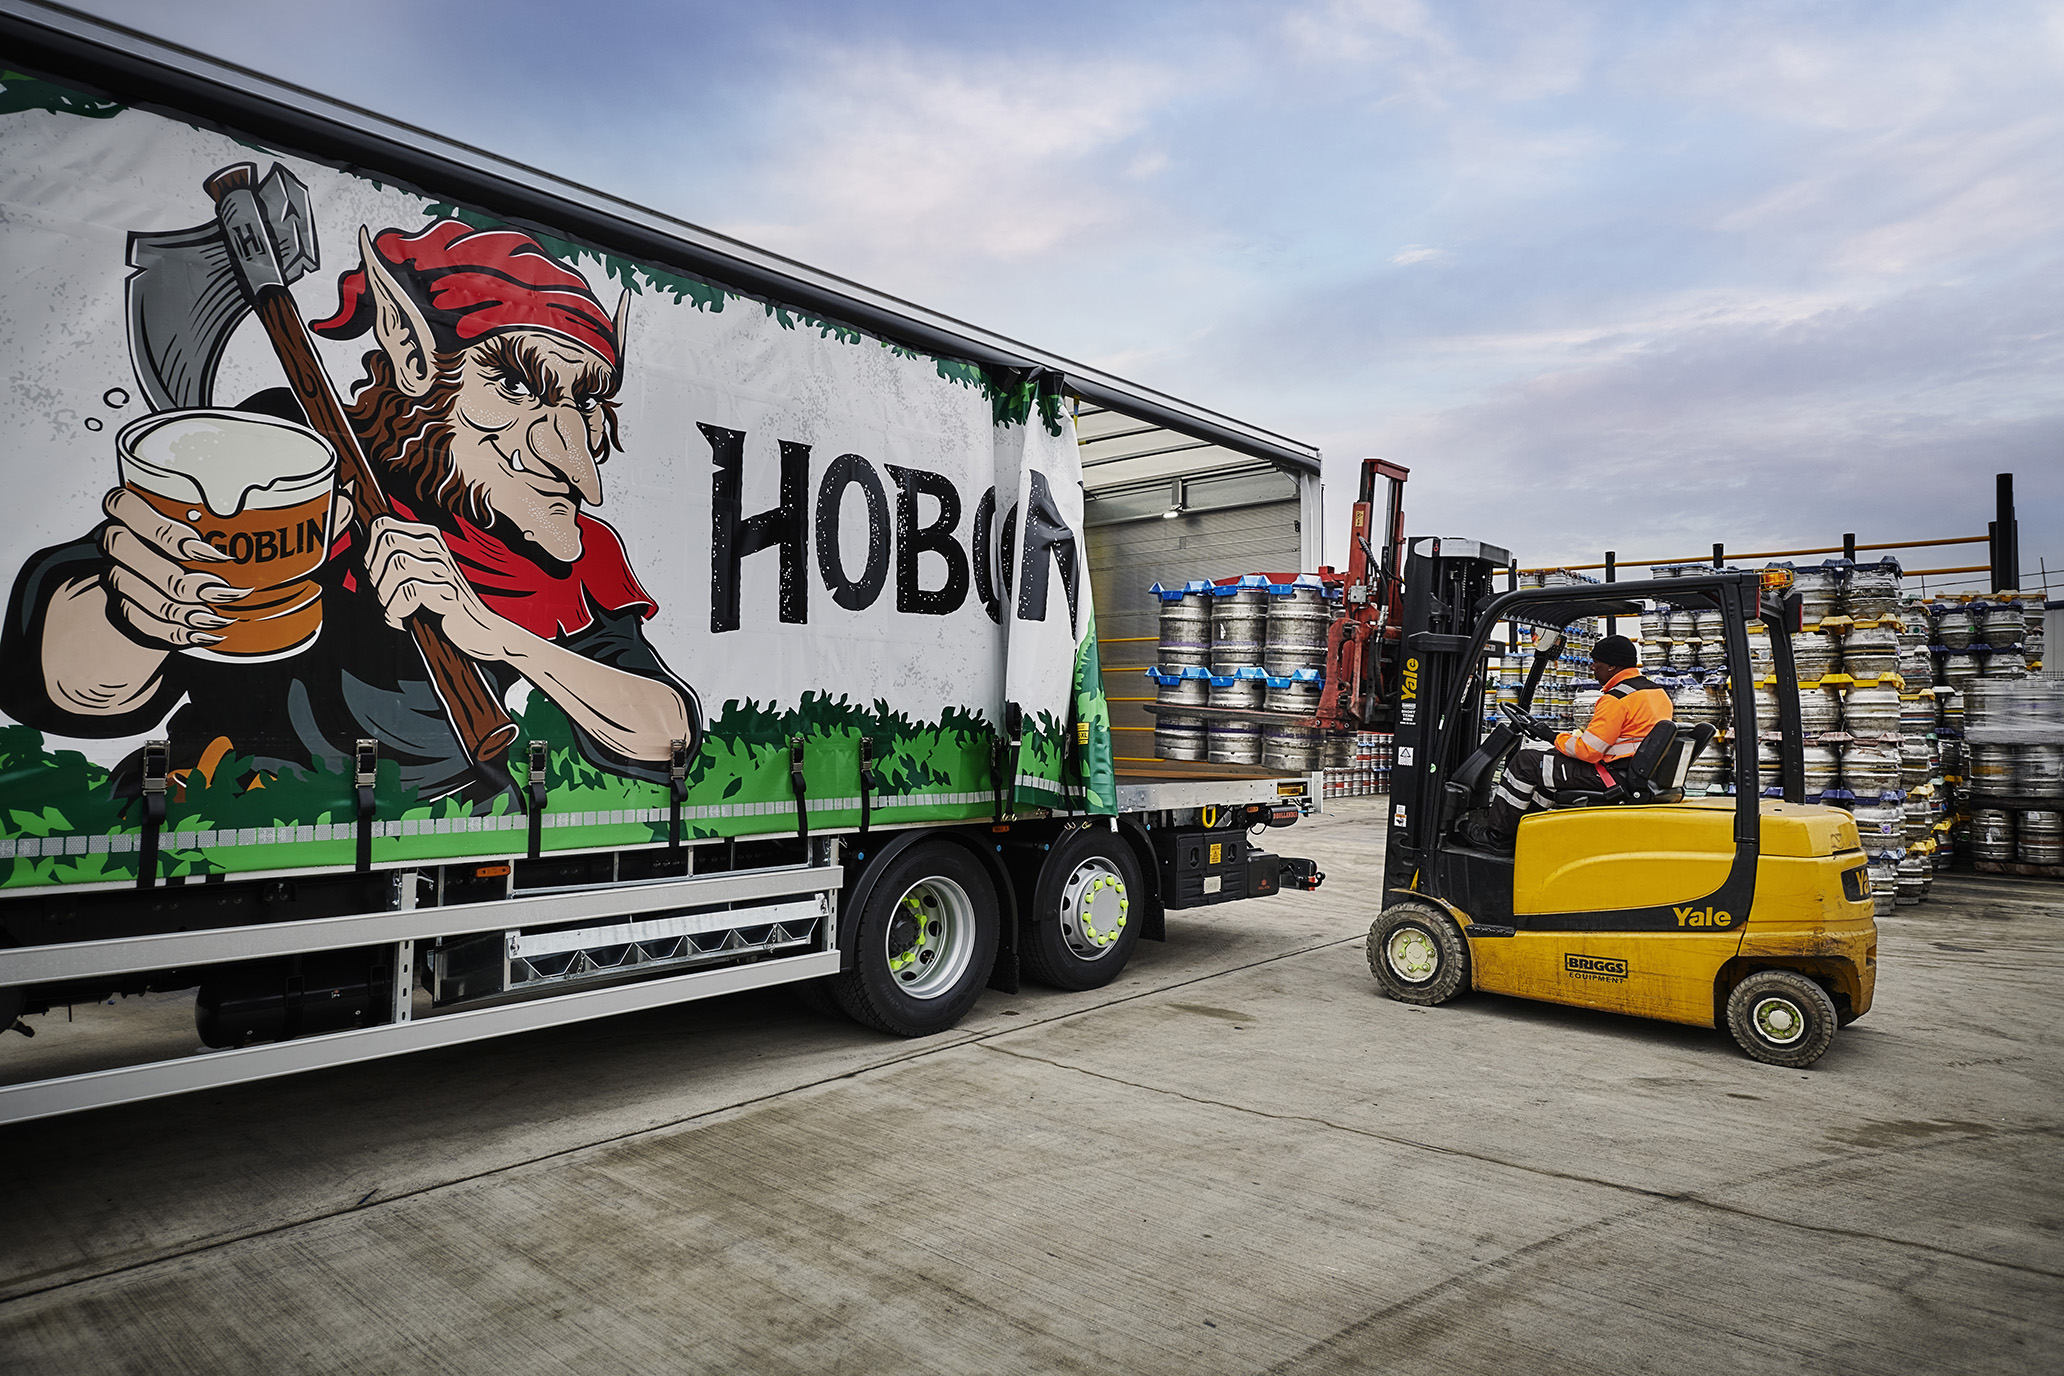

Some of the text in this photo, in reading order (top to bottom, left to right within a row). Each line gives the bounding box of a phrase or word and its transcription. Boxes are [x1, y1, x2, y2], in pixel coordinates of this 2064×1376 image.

[204, 510, 329, 565] GOBLIN
[1400, 657, 1419, 701] Yale
[1672, 906, 1732, 927] Yale
[1568, 957, 1624, 974] BRIGGS
[1569, 972, 1624, 984] EQUIPMENT
